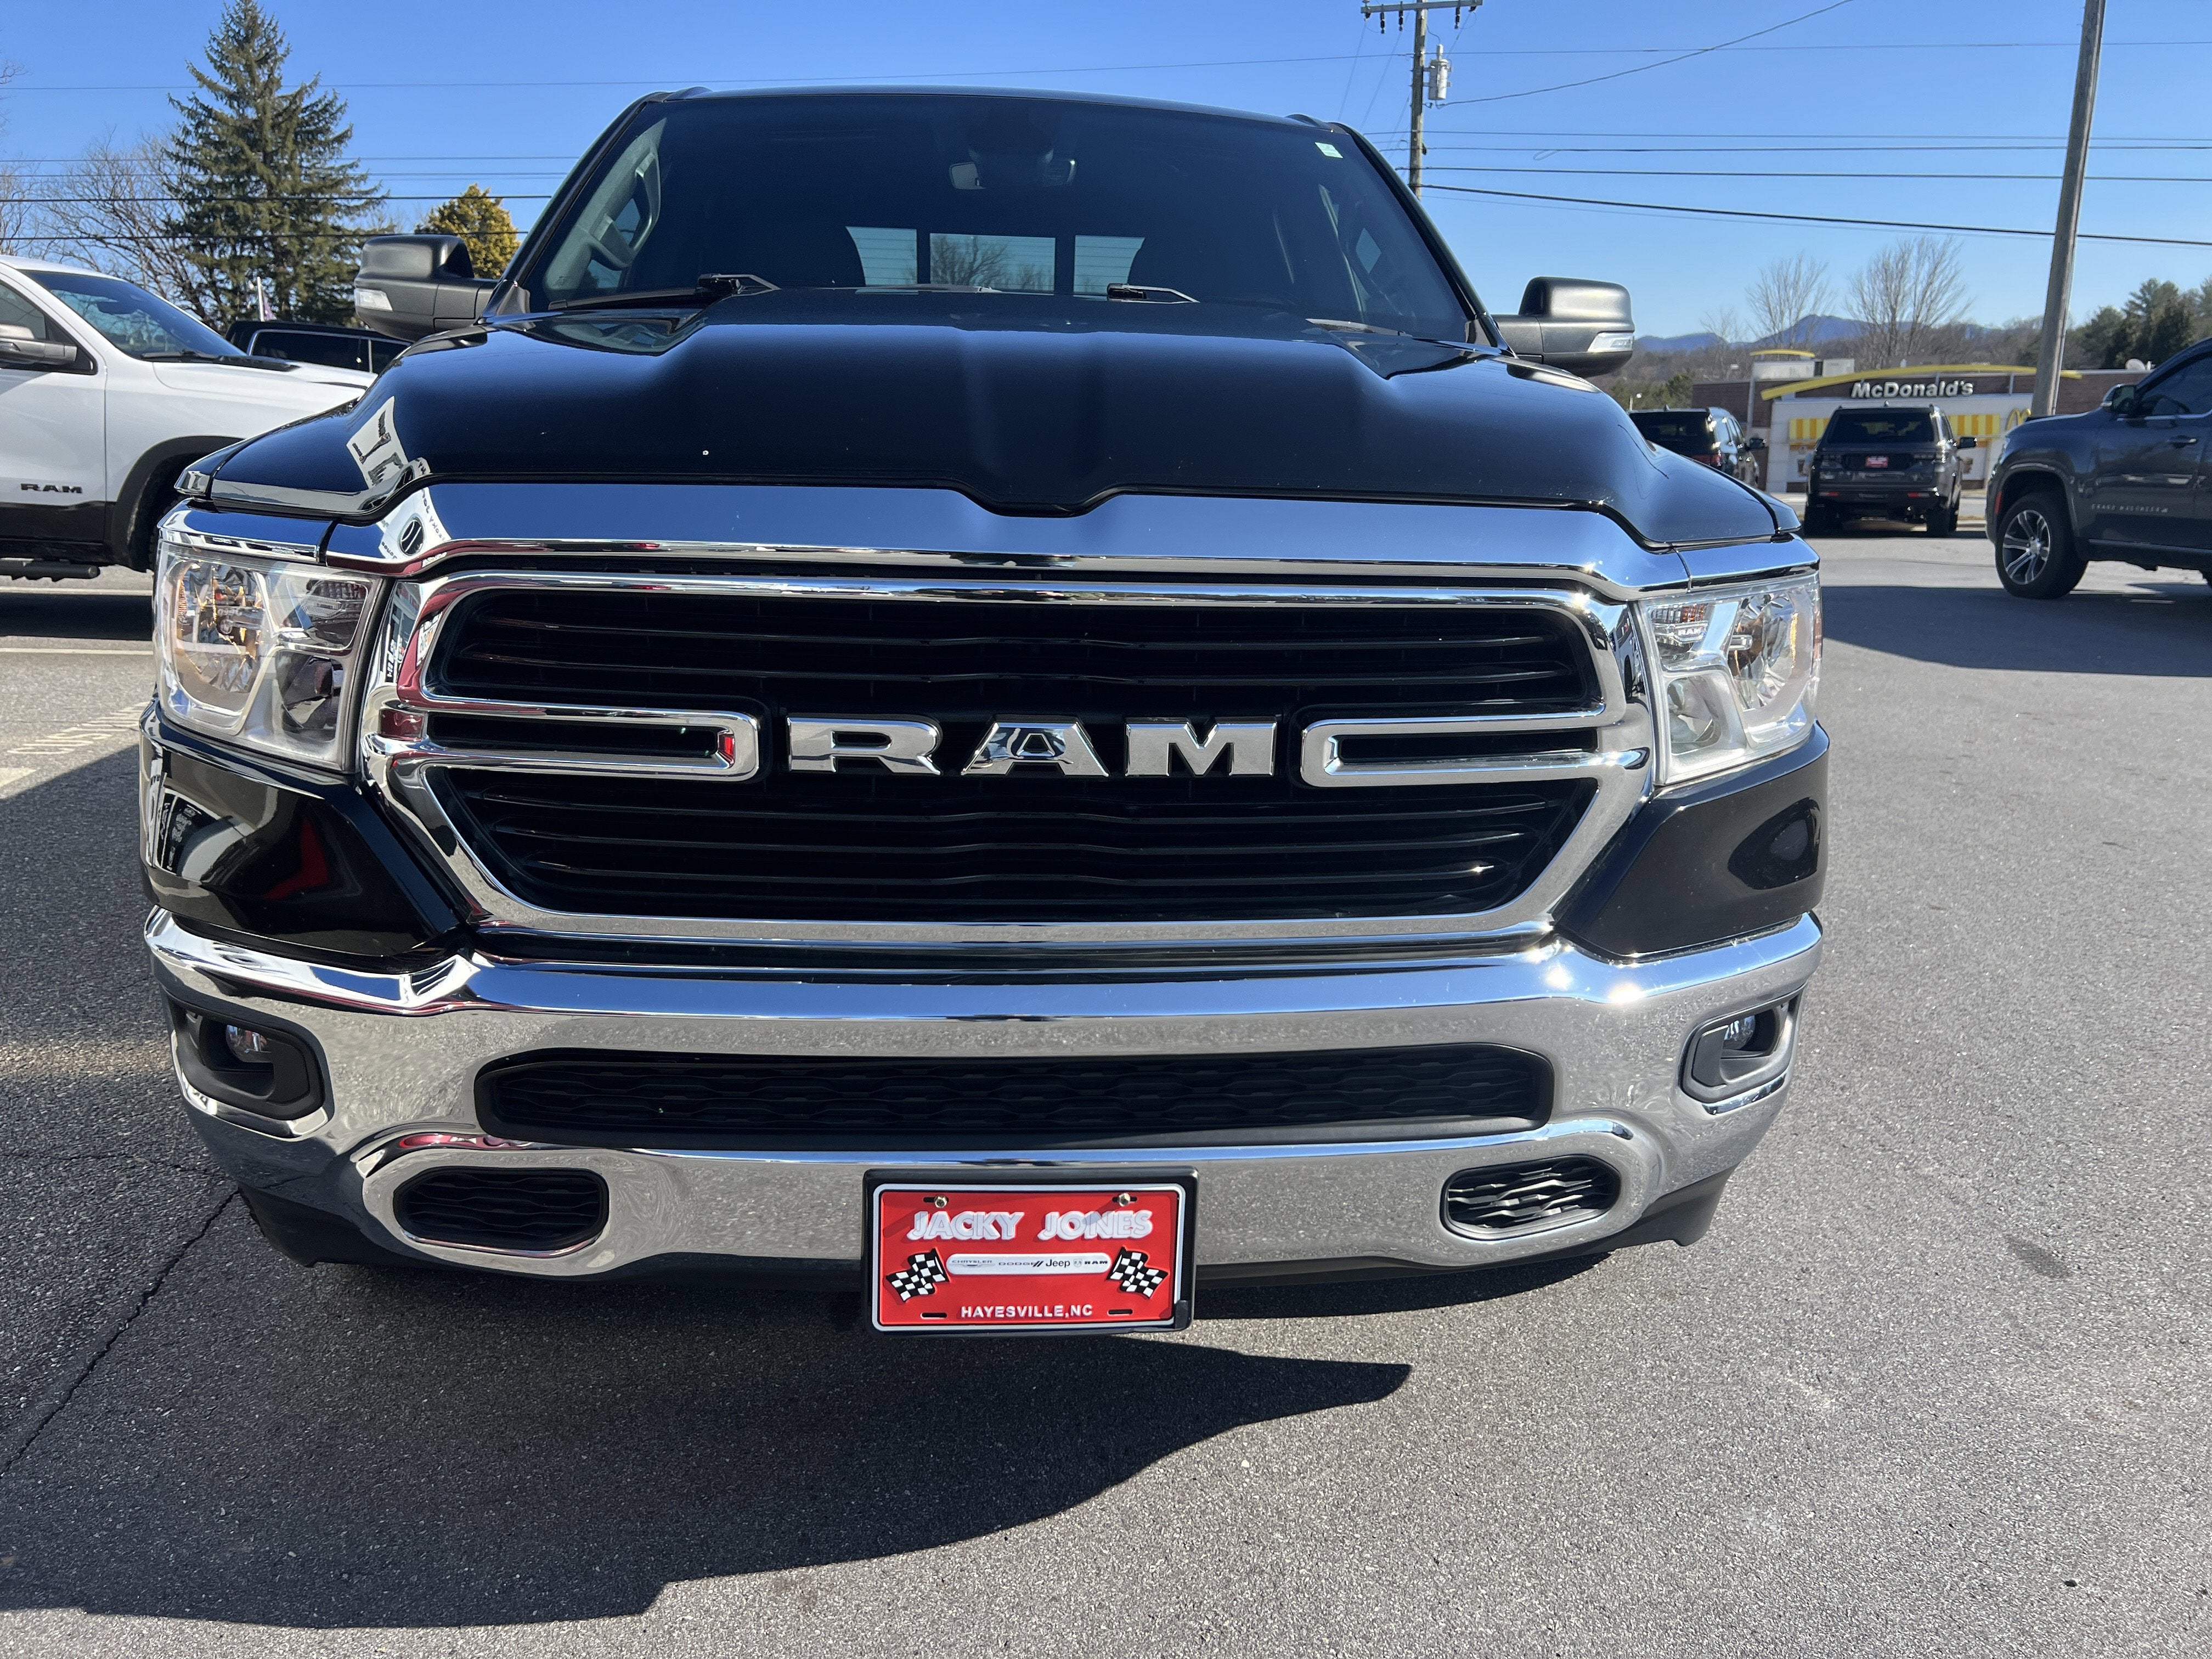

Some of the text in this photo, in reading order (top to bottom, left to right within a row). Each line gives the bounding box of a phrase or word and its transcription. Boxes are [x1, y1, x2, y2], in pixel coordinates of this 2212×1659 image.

[1850, 380, 1974, 399] McDonald's
[21, 483, 83, 494] RAM
[786, 715, 1278, 777] RAM
[906, 1210, 1153, 1240] JACKY JONES
[1046, 1259, 1070, 1268] Jeep
